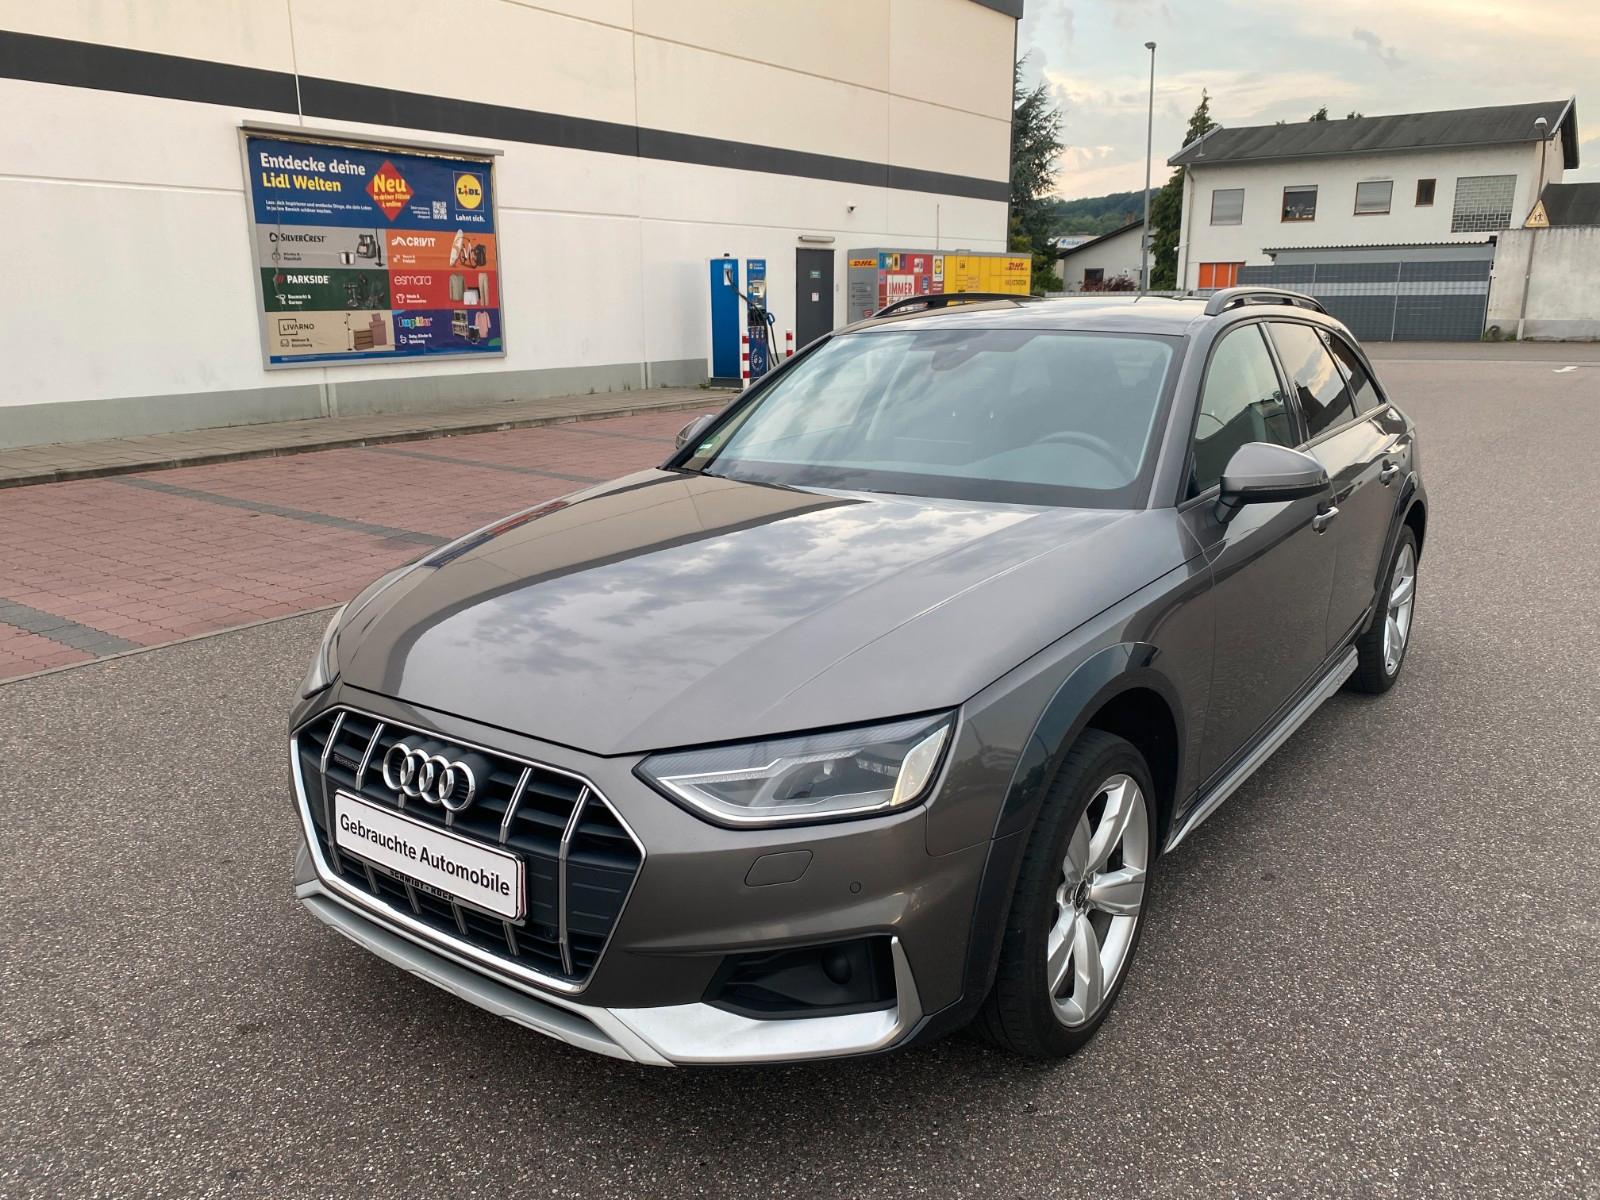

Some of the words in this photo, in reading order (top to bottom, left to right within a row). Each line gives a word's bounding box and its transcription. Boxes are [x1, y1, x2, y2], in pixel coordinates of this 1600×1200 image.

[260, 152, 326, 172] Entdecke
[329, 160, 366, 176] deine
[262, 172, 290, 188] Lidl
[293, 175, 342, 192] Welten
[373, 174, 407, 193] Neu
[406, 237, 436, 247] CRIVIT
[287, 275, 329, 284] PARKSIDE
[394, 275, 432, 286] esmara
[889, 282, 913, 295] IMMER
[282, 323, 315, 331] LIVARNO
[340, 813, 417, 860] Gebrauchte
[419, 846, 511, 897] Automobile
